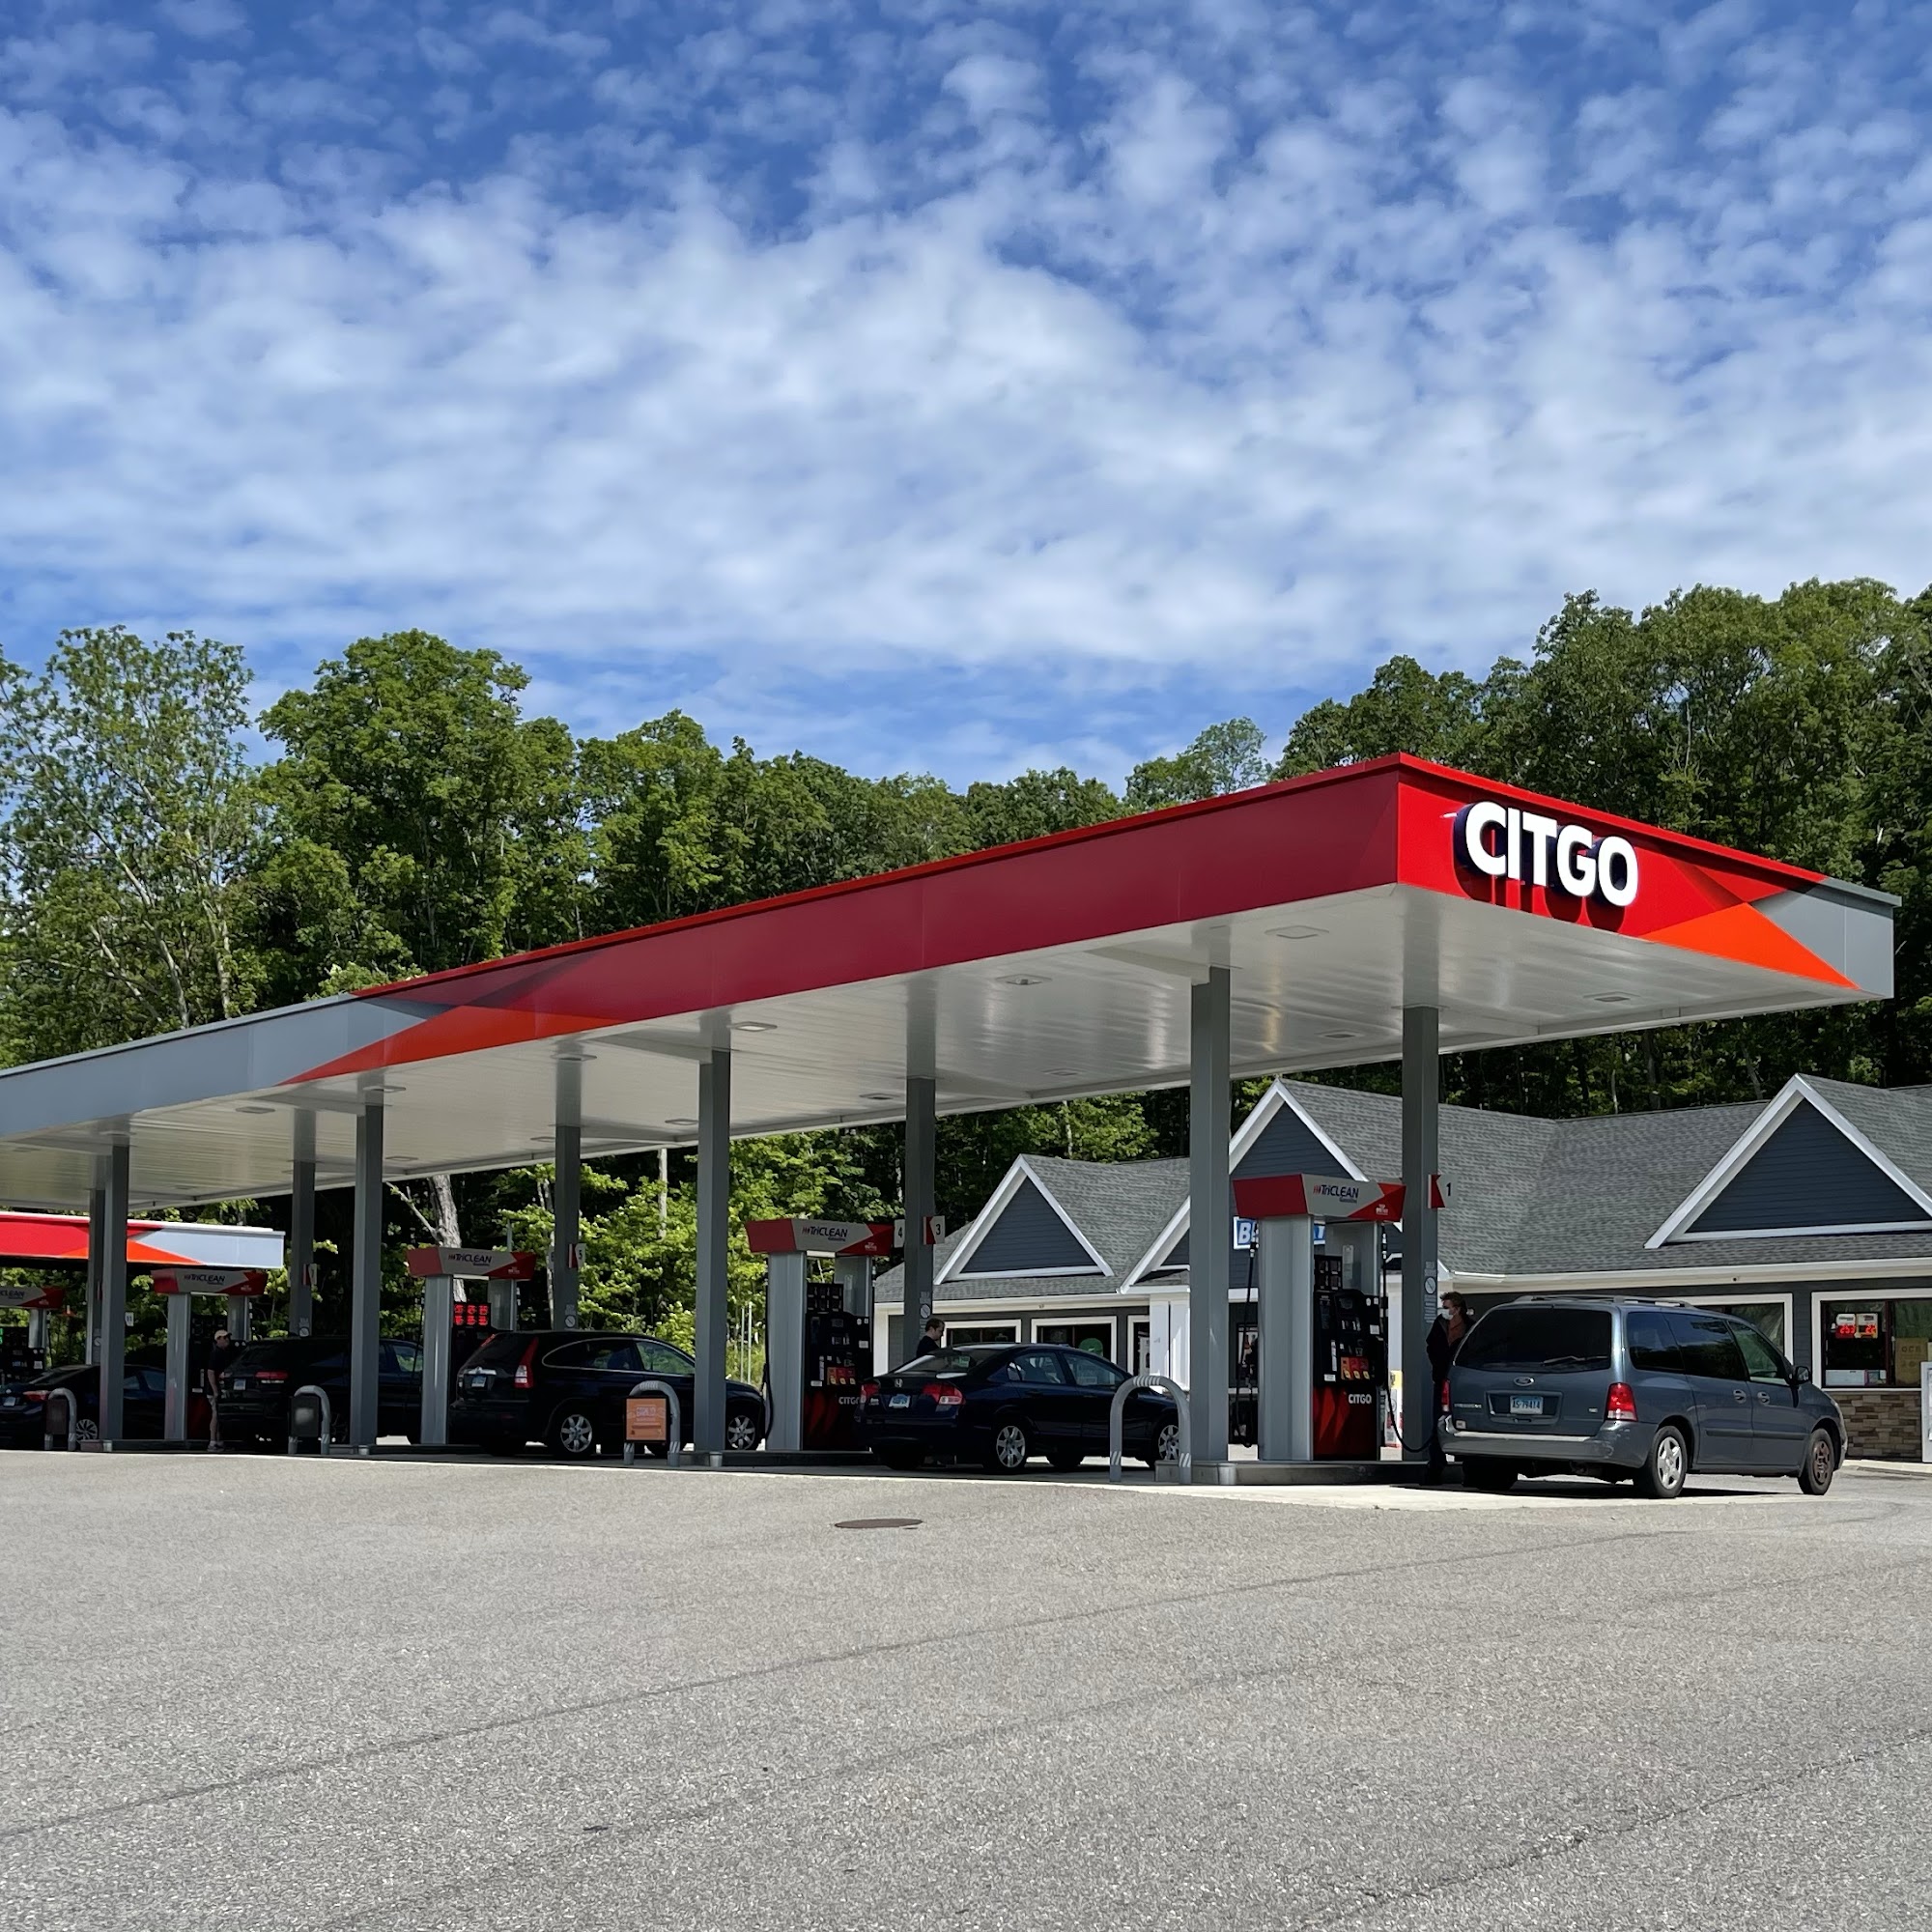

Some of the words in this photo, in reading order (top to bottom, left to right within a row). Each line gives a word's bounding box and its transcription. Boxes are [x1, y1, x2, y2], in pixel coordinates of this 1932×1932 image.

[1463, 801, 1638, 906] CITGO
[1321, 1184, 1359, 1199] TriCLEAN
[1446, 1182, 1451, 1197] 1
[810, 1226, 848, 1238] TriCLEAN
[897, 1226, 903, 1238] 4
[935, 1224, 941, 1235] 3
[455, 1253, 492, 1264] TriCLEAN
[1348, 1393, 1373, 1405] CITGO
